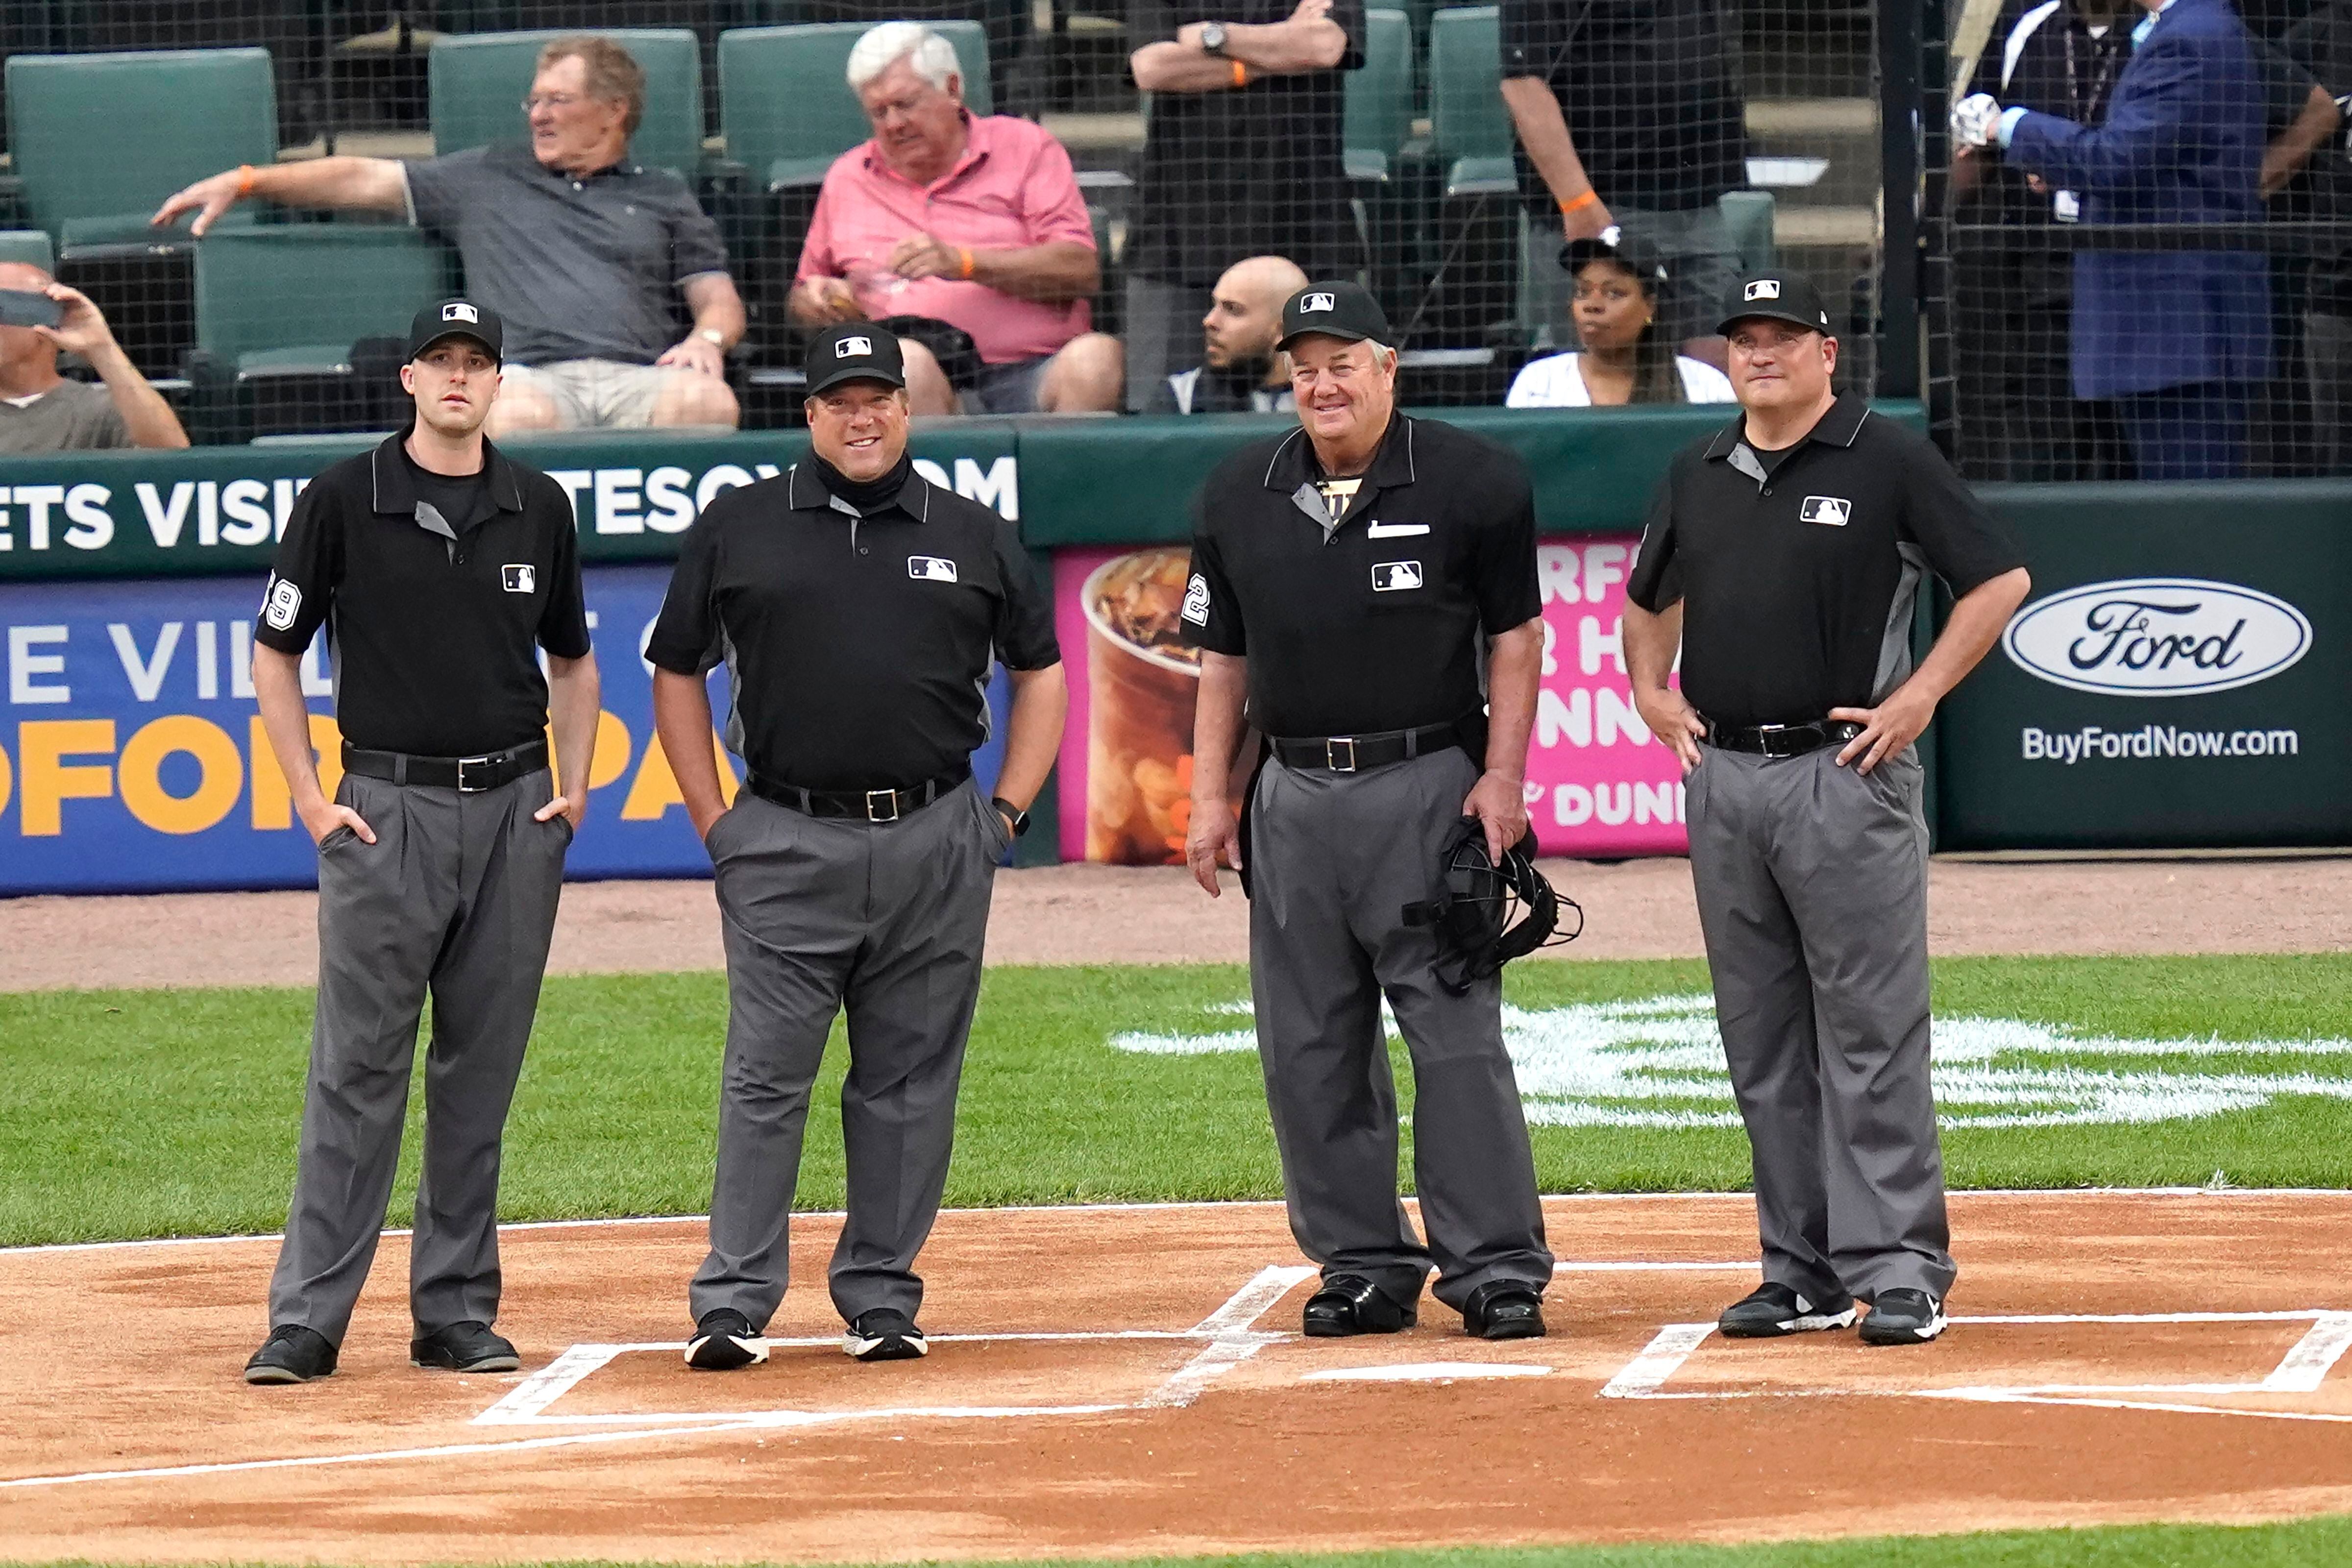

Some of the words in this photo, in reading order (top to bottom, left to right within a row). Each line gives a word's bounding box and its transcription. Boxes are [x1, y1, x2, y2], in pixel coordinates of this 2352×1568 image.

[134, 478, 314, 547] VISI
[1180, 568, 1210, 627] 2
[2068, 600, 2248, 670] Ford
[2022, 725, 2299, 764] BuyFordNow.com
